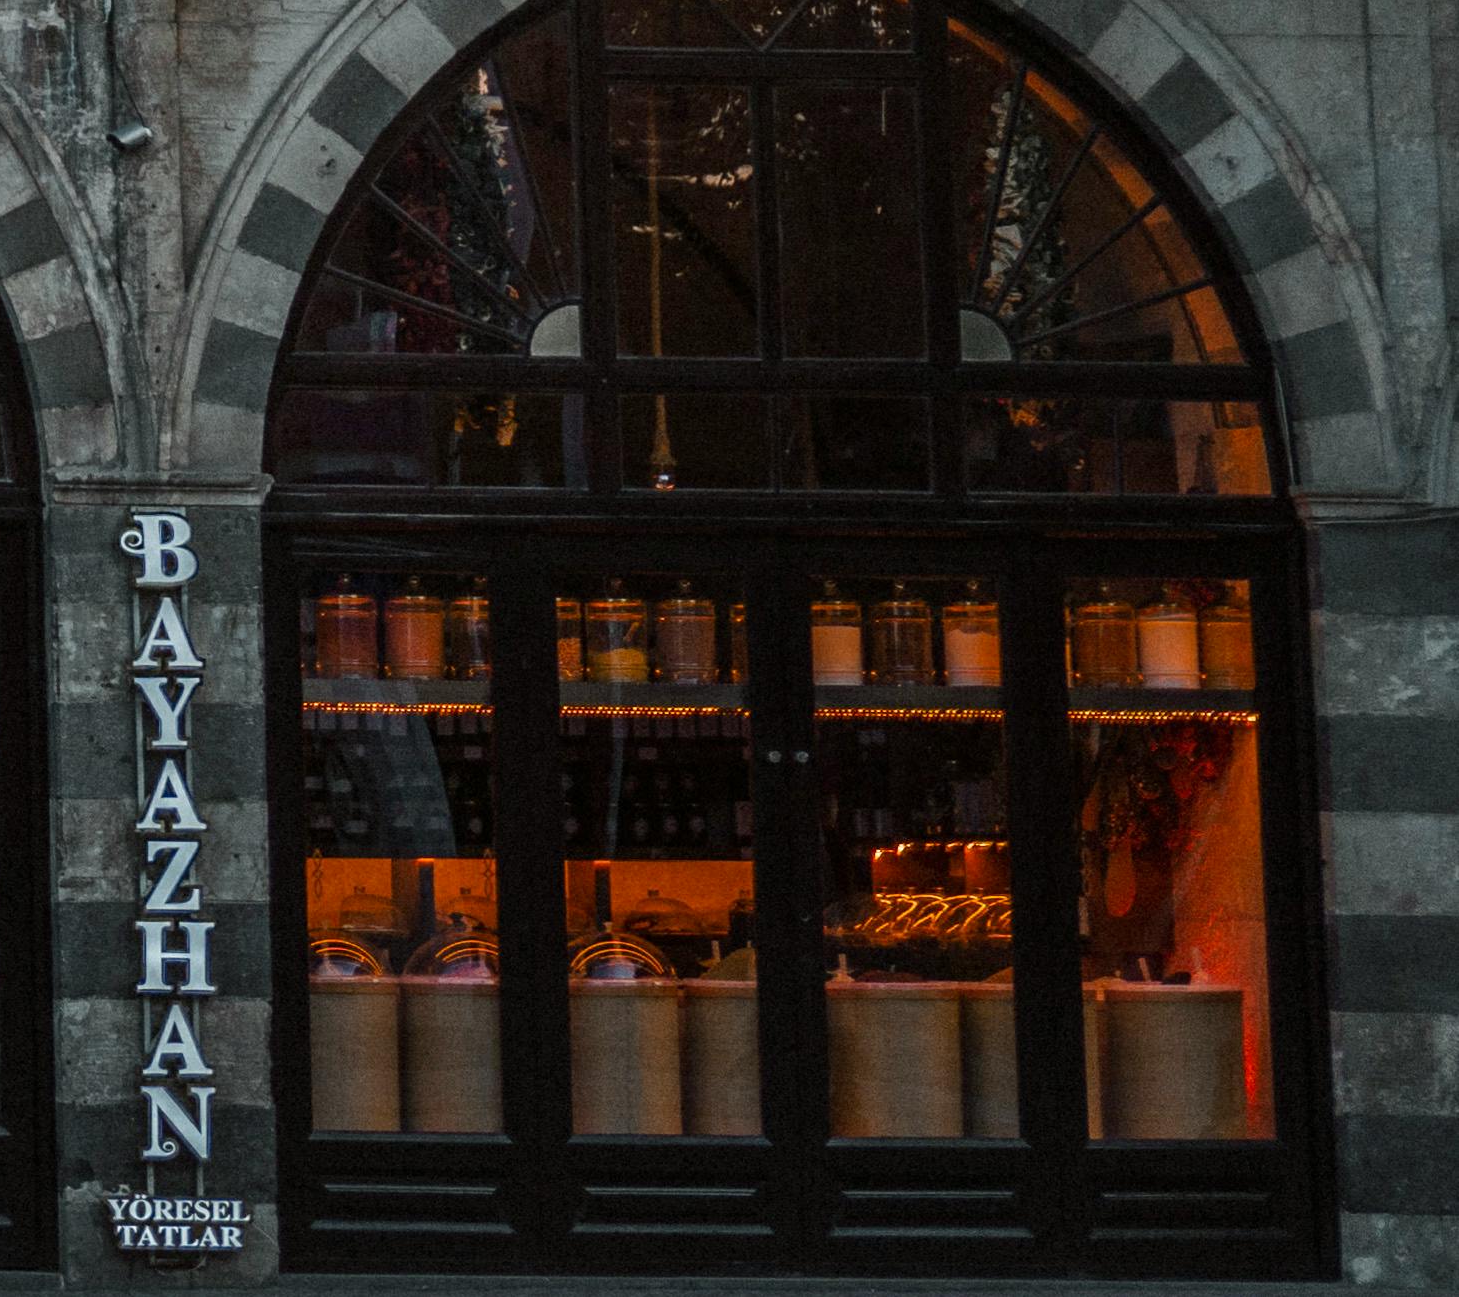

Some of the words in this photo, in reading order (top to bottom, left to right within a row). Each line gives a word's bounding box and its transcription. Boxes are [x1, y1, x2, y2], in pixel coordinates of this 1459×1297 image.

[120, 513, 215, 1160] BAYAZHAN
[107, 1195, 250, 1222] YÖRESEL
[117, 1224, 243, 1248] TATLAR
